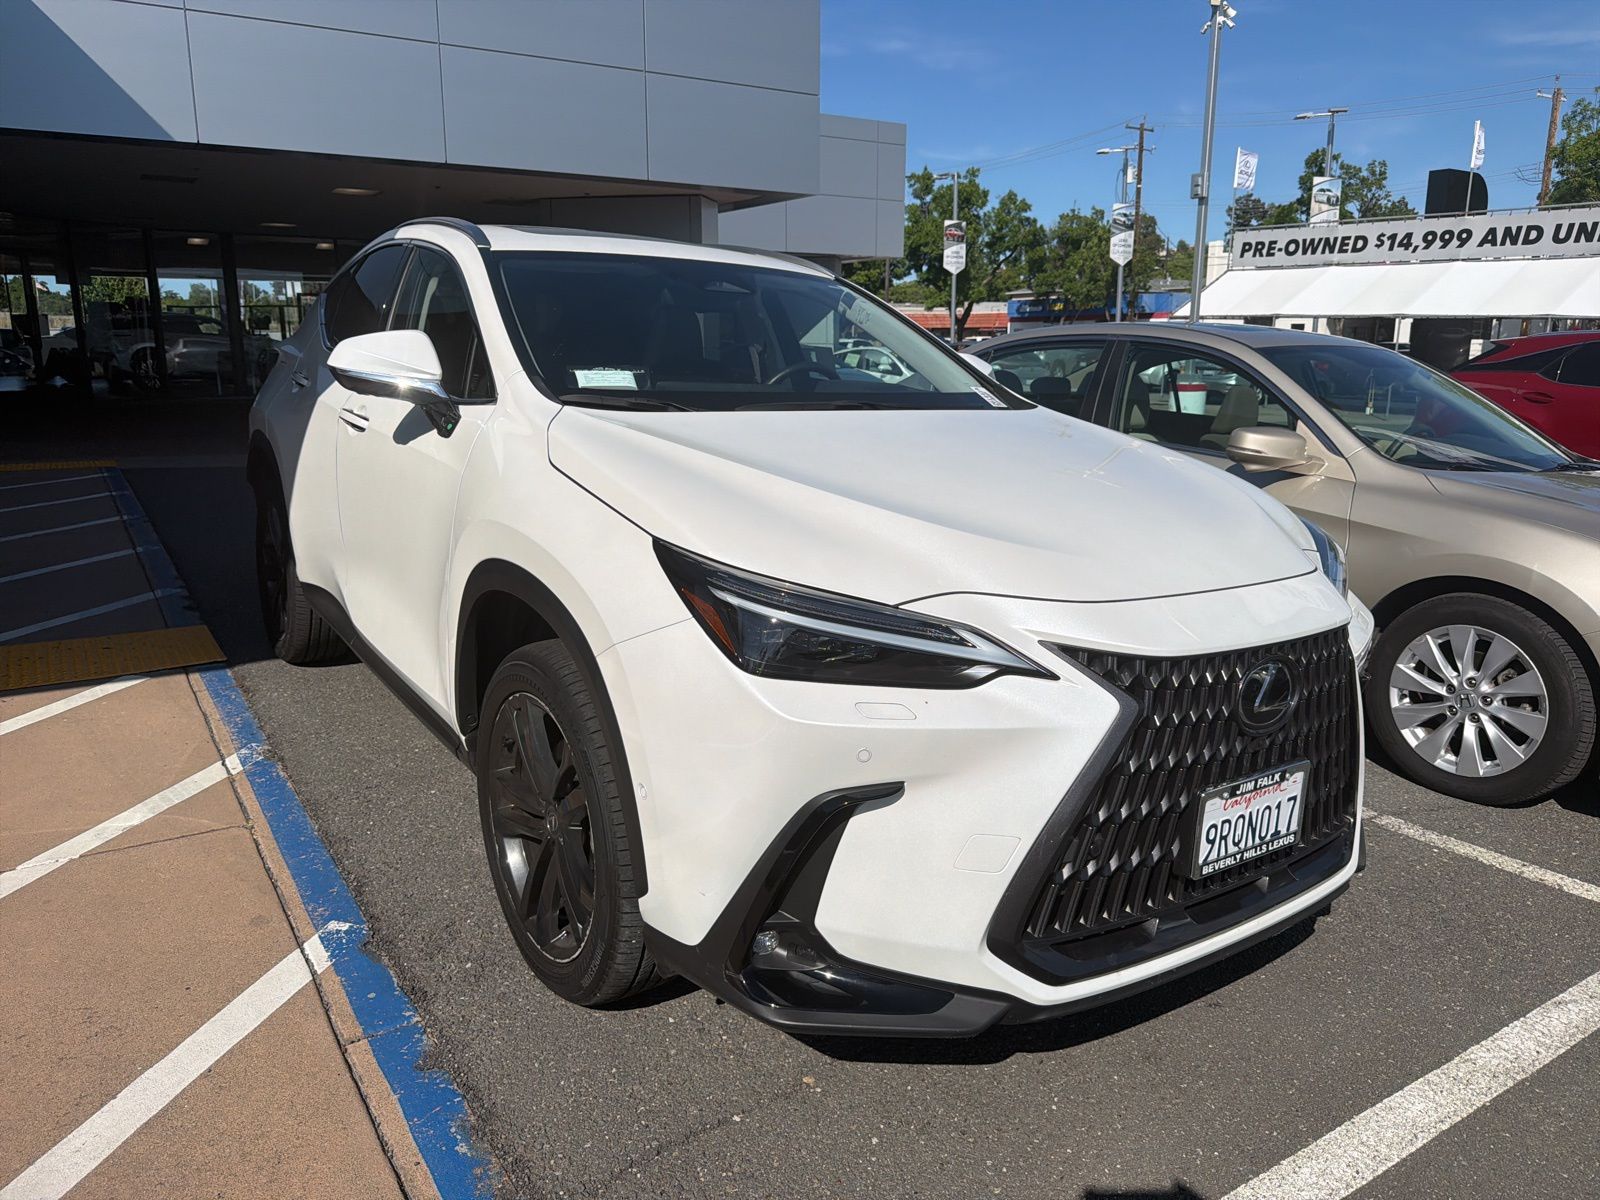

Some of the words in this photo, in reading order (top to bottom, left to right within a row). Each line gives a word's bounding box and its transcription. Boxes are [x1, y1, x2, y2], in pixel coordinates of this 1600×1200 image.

[1240, 235, 1368, 258] PRE-OWNED
[1374, 228, 1473, 253] $14,999
[1477, 225, 1544, 247] AND
[1552, 221, 1600, 244] UN
[1223, 783, 1287, 811] California
[1236, 781, 1255, 795] JIM
[1256, 772, 1281, 786] FALK
[1203, 795, 1298, 864] 9RQN017
[1202, 853, 1242, 875] BEVERLY
[1243, 843, 1267, 860] HILLS
[1269, 834, 1295, 851] LEXUS
